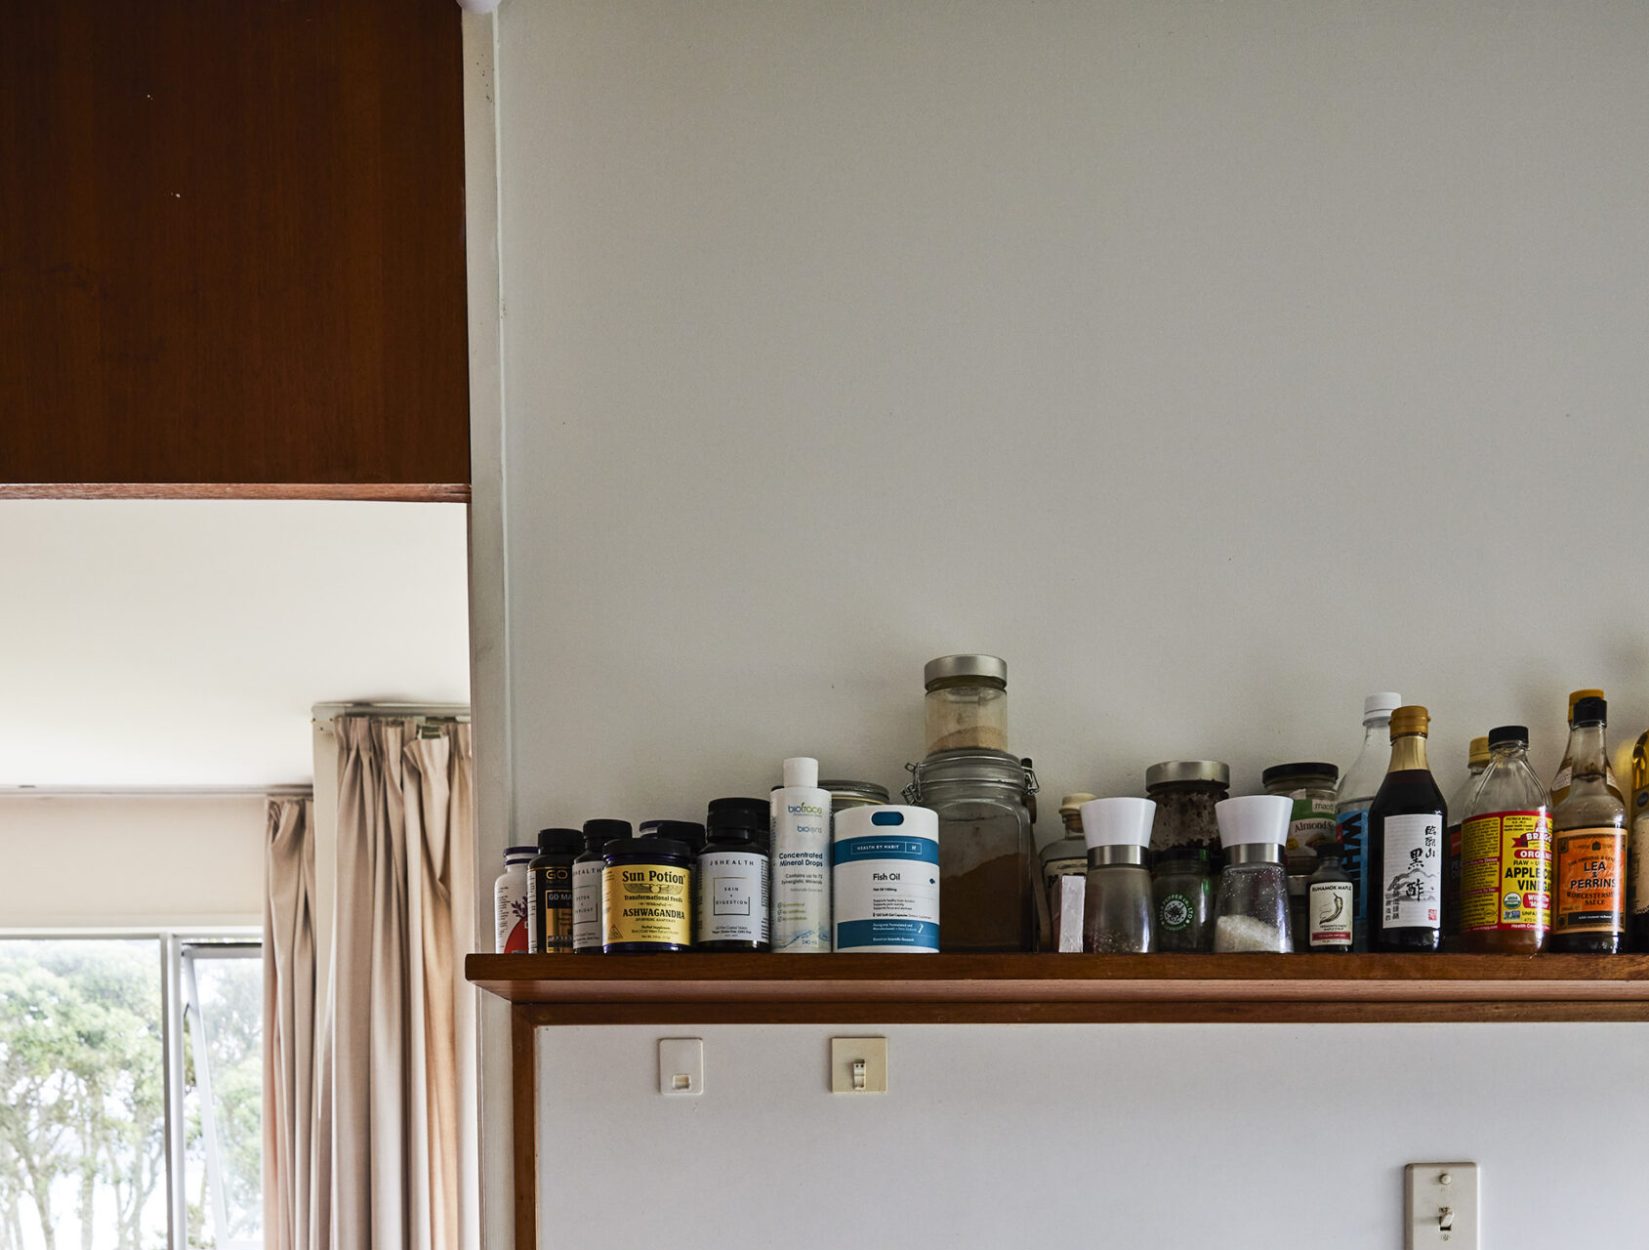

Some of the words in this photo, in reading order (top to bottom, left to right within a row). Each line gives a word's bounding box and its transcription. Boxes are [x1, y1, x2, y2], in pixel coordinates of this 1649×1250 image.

[1295, 820, 1327, 832] Almond
[778, 852, 823, 860] Concentrated
[805, 859, 823, 867] Drops
[1584, 862, 1606, 872] LEA
[546, 869, 568, 880] GO
[622, 871, 645, 882] Sun
[649, 871, 684, 885] Potion
[872, 872, 888, 881] Fish
[889, 872, 901, 881] Oil
[1505, 867, 1541, 878] APPLE
[1571, 878, 1616, 889] PERRINS
[624, 894, 669, 902] Transformational
[623, 908, 685, 920] ASHWAGANDHA
